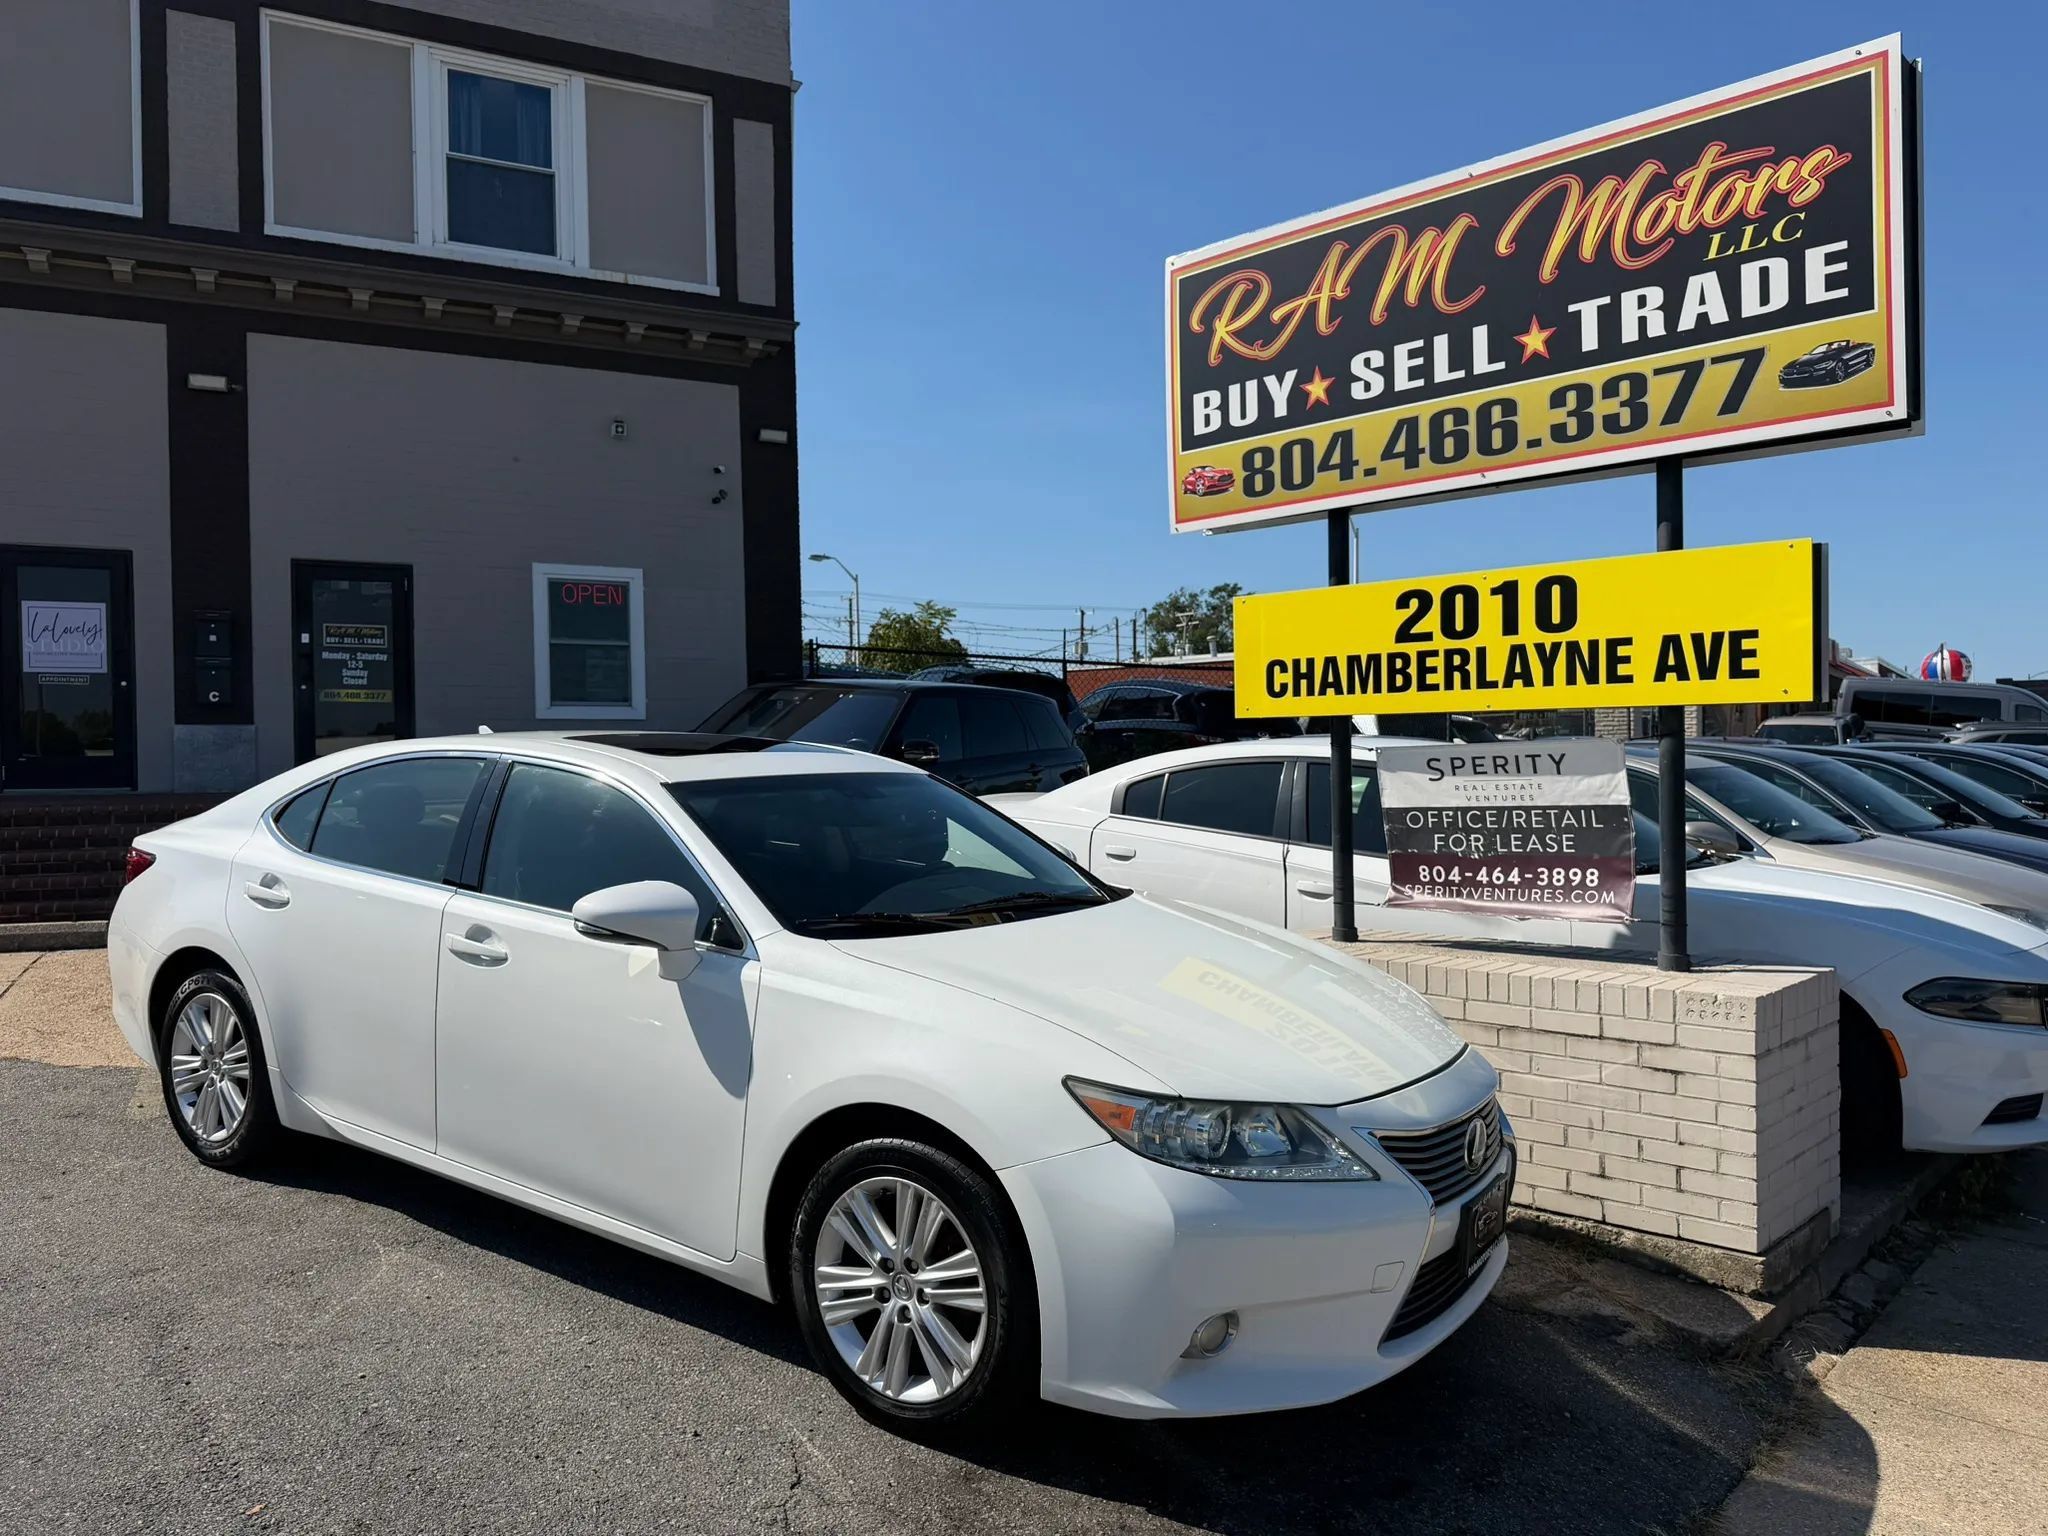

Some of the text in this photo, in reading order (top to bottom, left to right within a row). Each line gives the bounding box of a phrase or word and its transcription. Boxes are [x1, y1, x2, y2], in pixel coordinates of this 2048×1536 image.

[1704, 210, 1808, 262] LLC
[1189, 140, 1851, 366] RAM Motors
[1192, 239, 1849, 436] BUY SELL TRADE
[1242, 347, 1770, 499] 804.466.3377
[562, 583, 624, 606] OPEN
[1394, 574, 1578, 644] 2010
[321, 651, 350, 660] Monday
[356, 652, 388, 662] Saturday
[1265, 629, 1760, 700] CHAMBERLAYNE AVE
[342, 668, 369, 677] Sunday
[343, 677, 368, 685] Closed
[1426, 752, 1567, 782] SPERITY
[1454, 782, 1544, 792] REAL ESTATE
[1465, 794, 1535, 803] VENTURES
[1405, 808, 1605, 829] OFFICE/RETAIL
[1434, 833, 1576, 853] FOR LEASE
[1418, 865, 1600, 888] 804-464-3898
[1404, 883, 1616, 905] SPERITYVENTURES.COM
